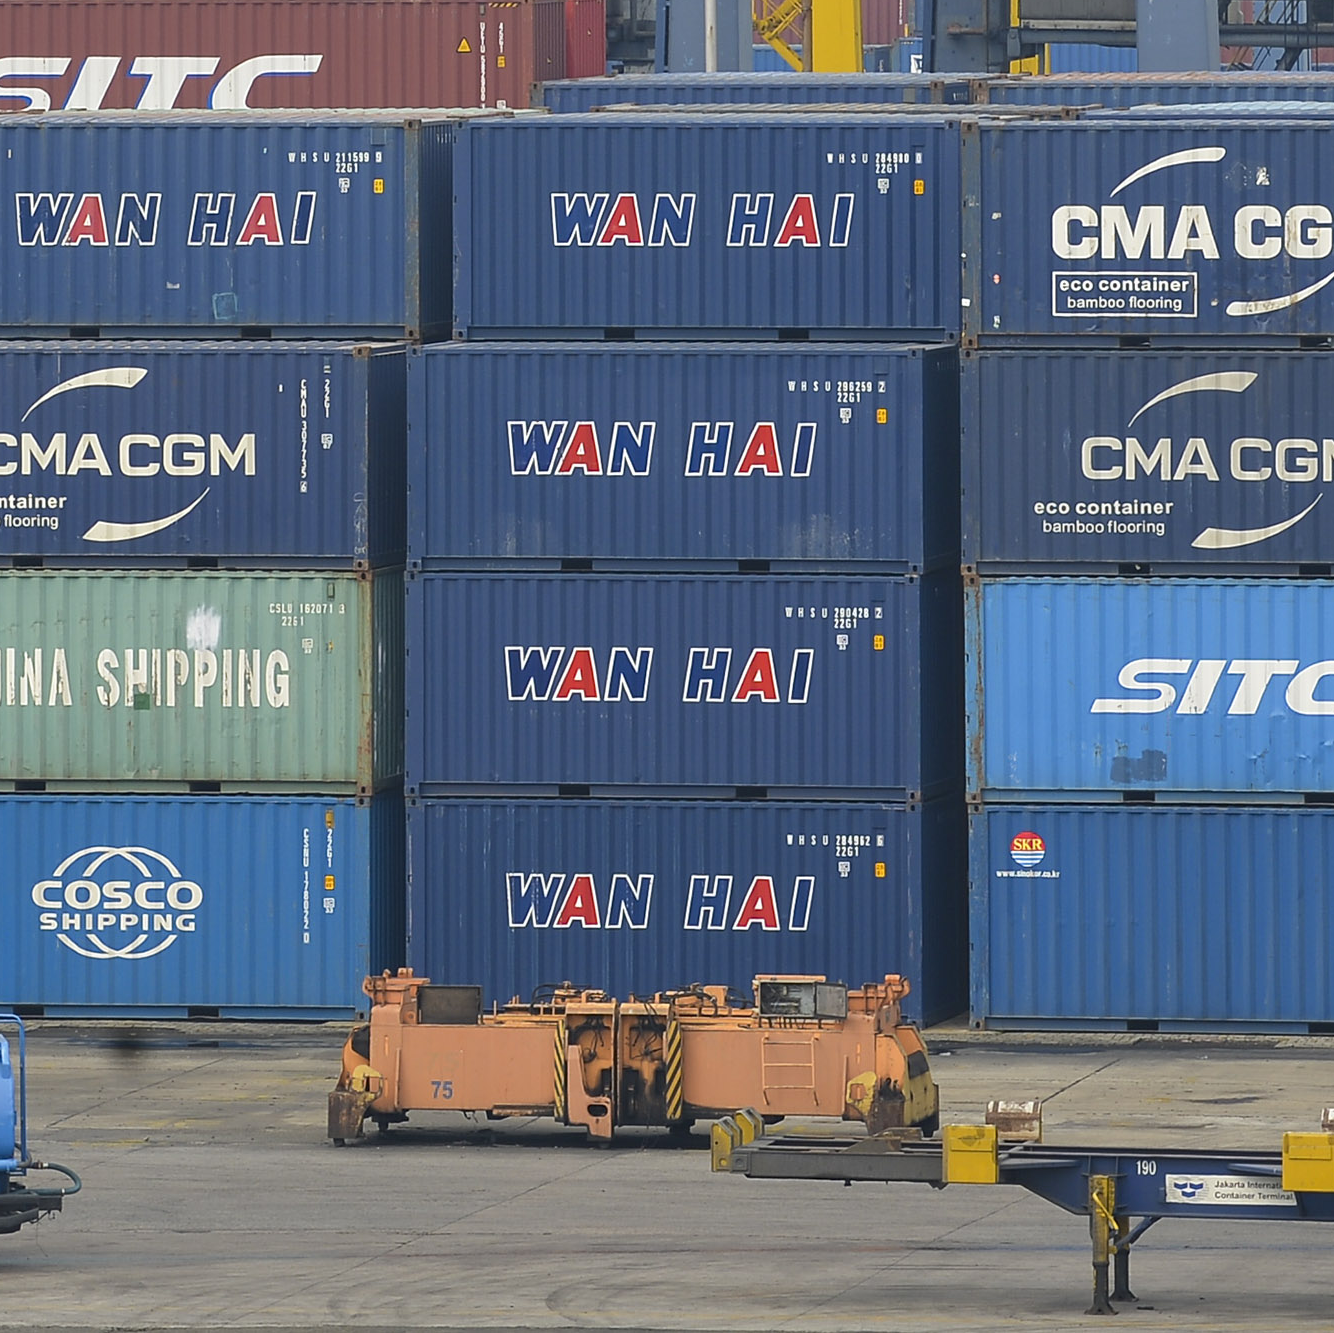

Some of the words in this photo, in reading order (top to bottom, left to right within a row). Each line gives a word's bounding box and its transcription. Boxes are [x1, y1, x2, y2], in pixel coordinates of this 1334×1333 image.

[16, 193, 161, 246] WAN
[188, 192, 316, 245] HAI
[551, 193, 696, 246] WAN
[727, 194, 854, 247] HAI
[1052, 206, 1219, 259] CMA
[1060, 280, 1093, 291] eco
[1096, 274, 1192, 291] container
[1068, 296, 1125, 308] bamboo
[1126, 296, 1181, 314] flooring
[120, 434, 255, 476] CGM
[507, 421, 656, 475] WAN
[685, 422, 816, 477] HAI
[1082, 437, 1219, 480] CMA
[1035, 503, 1069, 514] eco
[1076, 500, 1173, 514] container
[4, 514, 58, 529] flooring
[1043, 520, 1104, 533] bamboo
[1108, 521, 1164, 536] flooring
[97, 645, 289, 707] SHIPPING
[505, 647, 653, 701] WAN
[683, 648, 814, 703] HAI
[1012, 837, 1044, 852] SKR
[32, 881, 202, 914] COSCO
[506, 873, 654, 931] WAN
[684, 875, 814, 930] HAI
[40, 913, 195, 931] SHIPPING
[430, 1079, 455, 1101] 75
[1137, 1161, 1156, 1175] 190
[1215, 1178, 1246, 1188] Jakarta
[1246, 1180, 1282, 1190] Internati
[1258, 1190, 1294, 1200] Terminal
